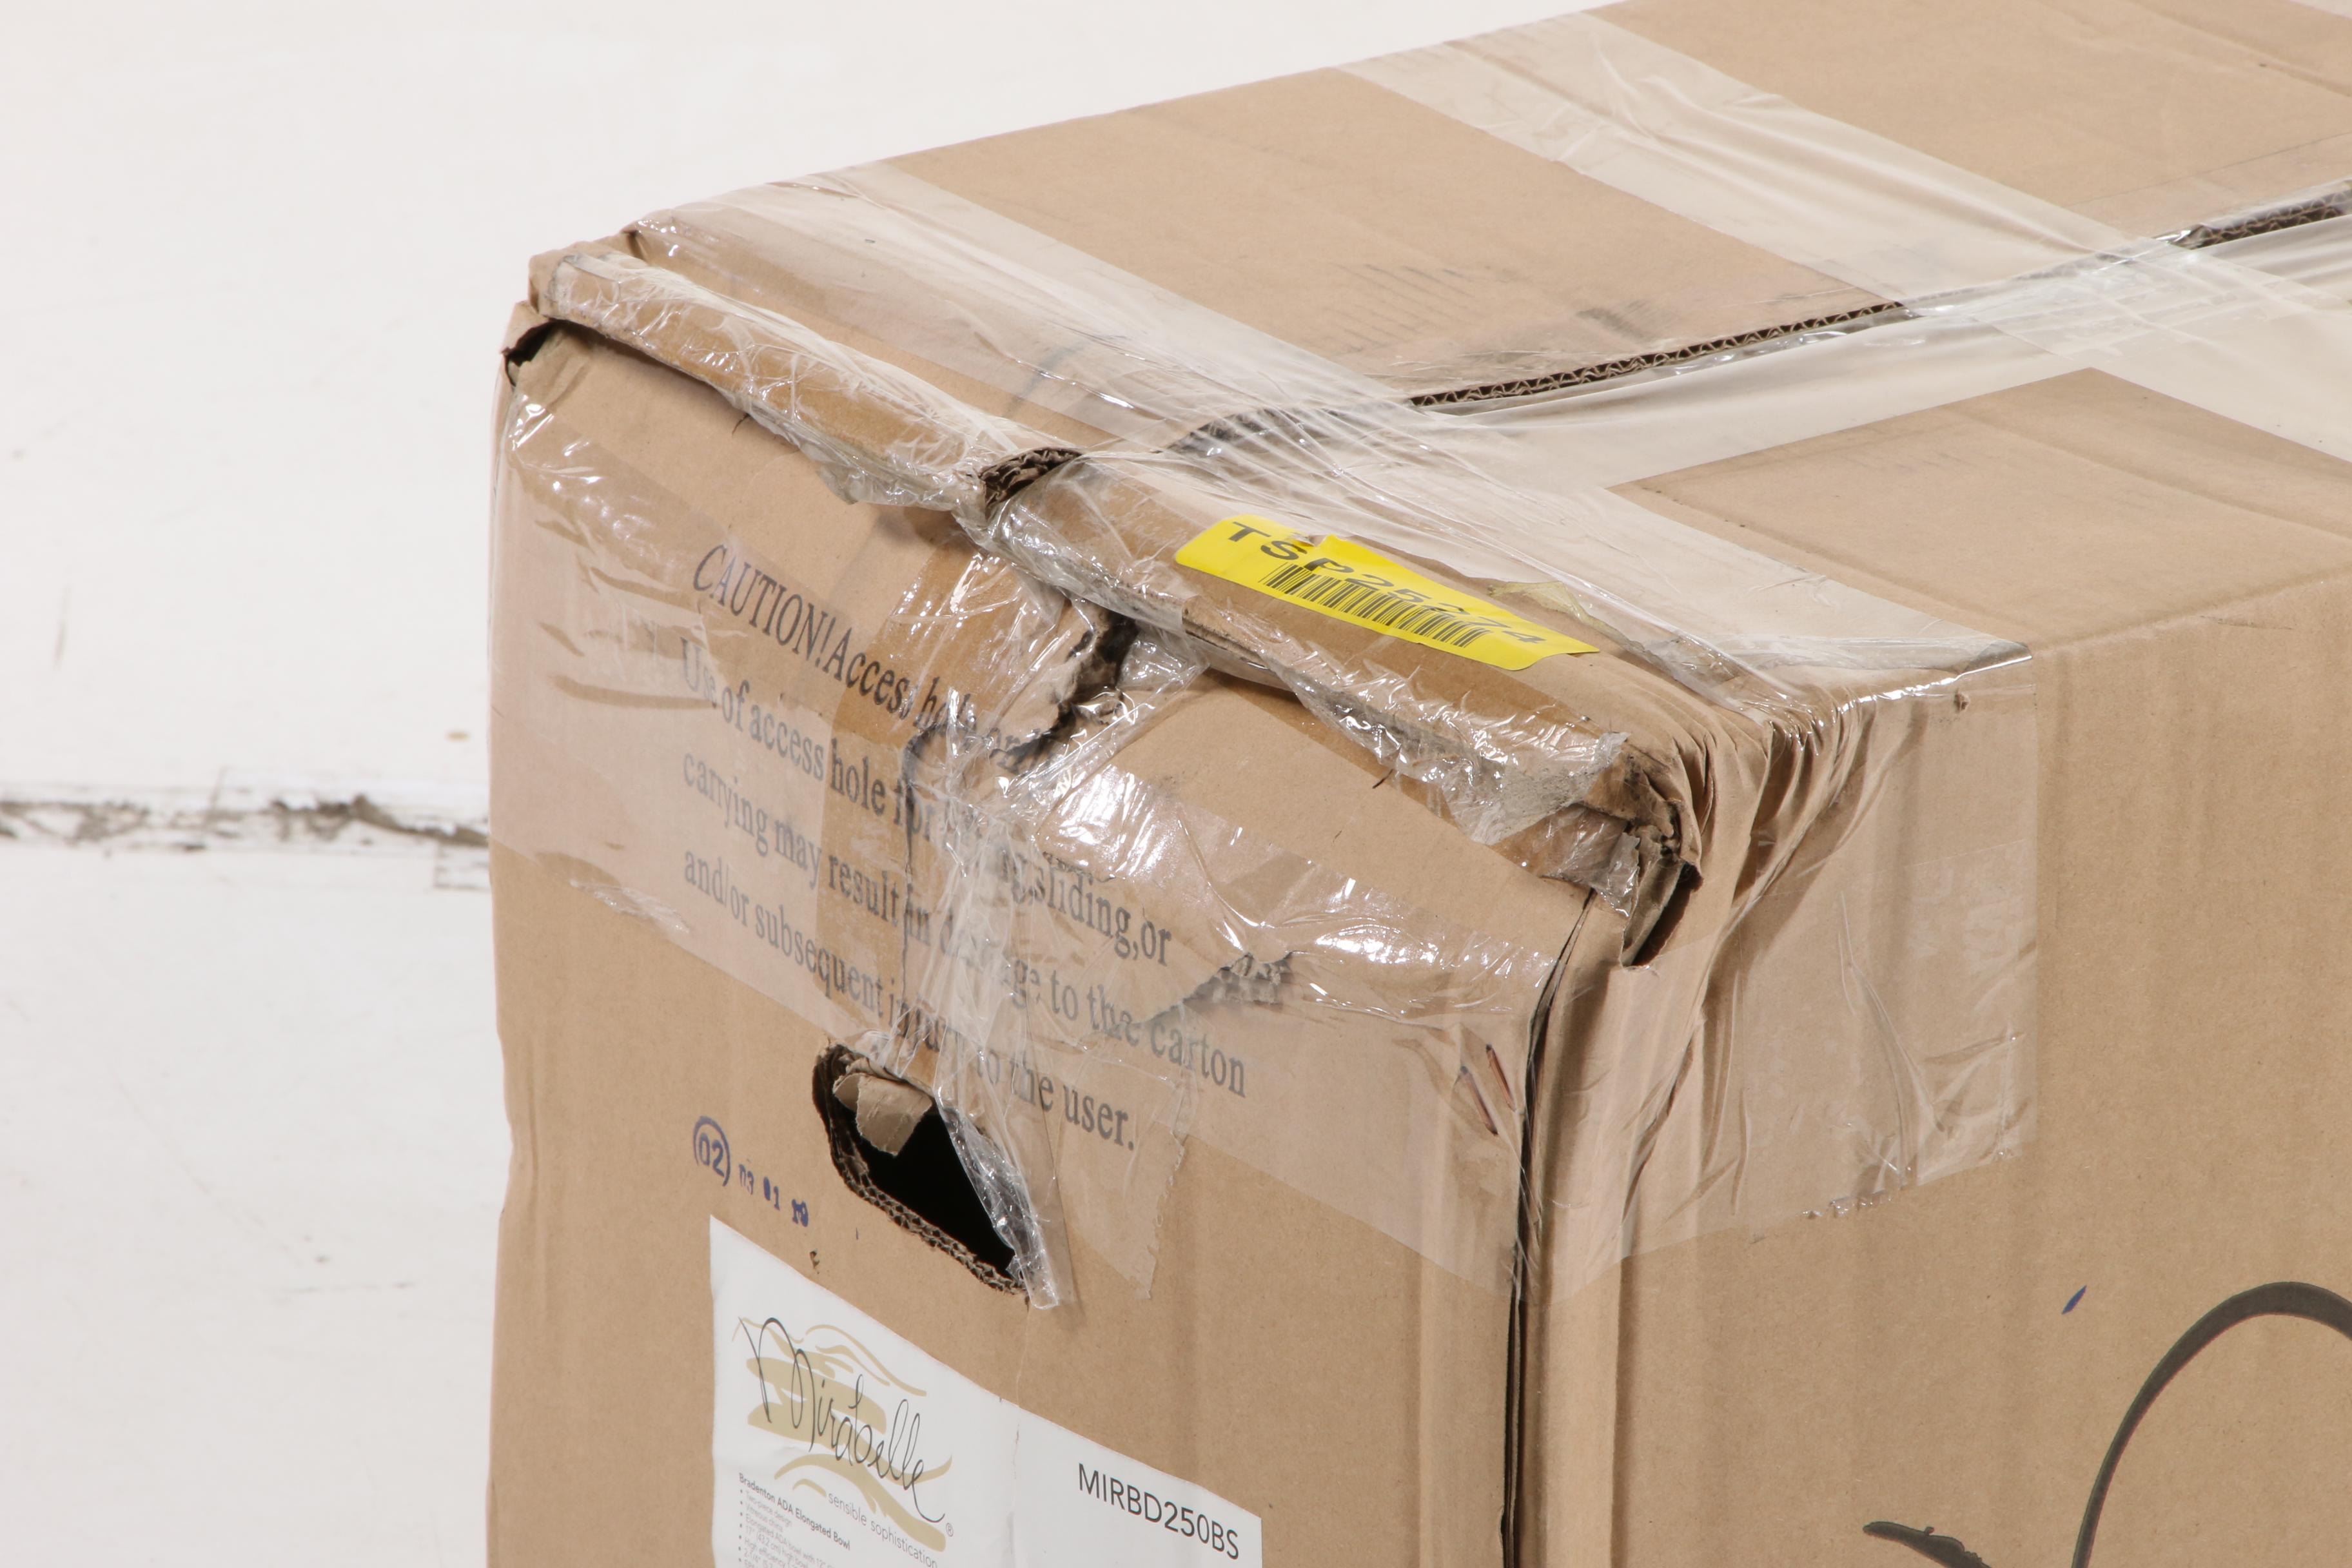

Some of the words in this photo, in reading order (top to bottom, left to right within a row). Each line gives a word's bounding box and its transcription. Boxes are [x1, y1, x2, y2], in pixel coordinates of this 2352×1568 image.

[721, 680, 750, 733] of
[750, 704, 825, 783] access
[830, 738, 887, 816] hole
[683, 753, 769, 858] carrying
[774, 817, 822, 890] may
[828, 854, 899, 927] result
[1050, 968, 1079, 1022] to
[1087, 984, 1141, 1048] the
[1150, 1017, 1247, 1099] carton
[684, 850, 750, 927] and/or
[755, 904, 883, 1019] subsequent
[1062, 1083, 1135, 1152] user.
[738, 1317, 946, 1523] Mirabelle
[739, 1472, 776, 1504] Bradenton
[777, 1496, 794, 1515] ADA
[795, 1507, 832, 1539] Elongated
[833, 1531, 851, 1551] Bowl
[828, 1493, 867, 1526] sensible
[870, 1520, 937, 1568] sophistication
[1078, 1462, 1239, 1560] MIRBD250BS
